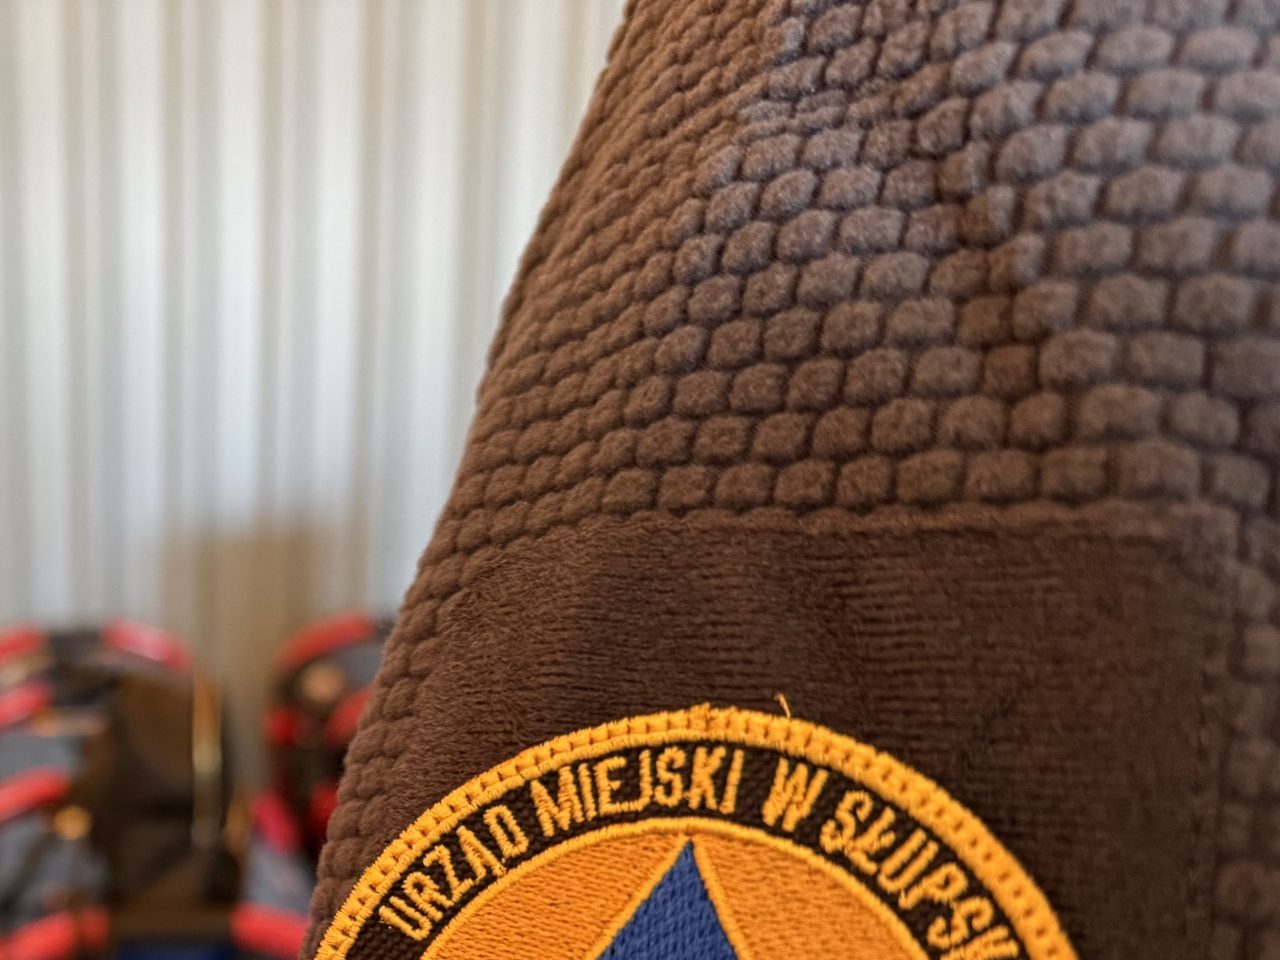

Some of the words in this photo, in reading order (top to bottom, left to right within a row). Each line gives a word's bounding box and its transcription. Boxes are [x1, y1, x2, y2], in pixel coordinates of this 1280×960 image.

[378, 804, 529, 940] URZĄD
[528, 746, 745, 837] MIEJSKI
[762, 756, 829, 832] W
